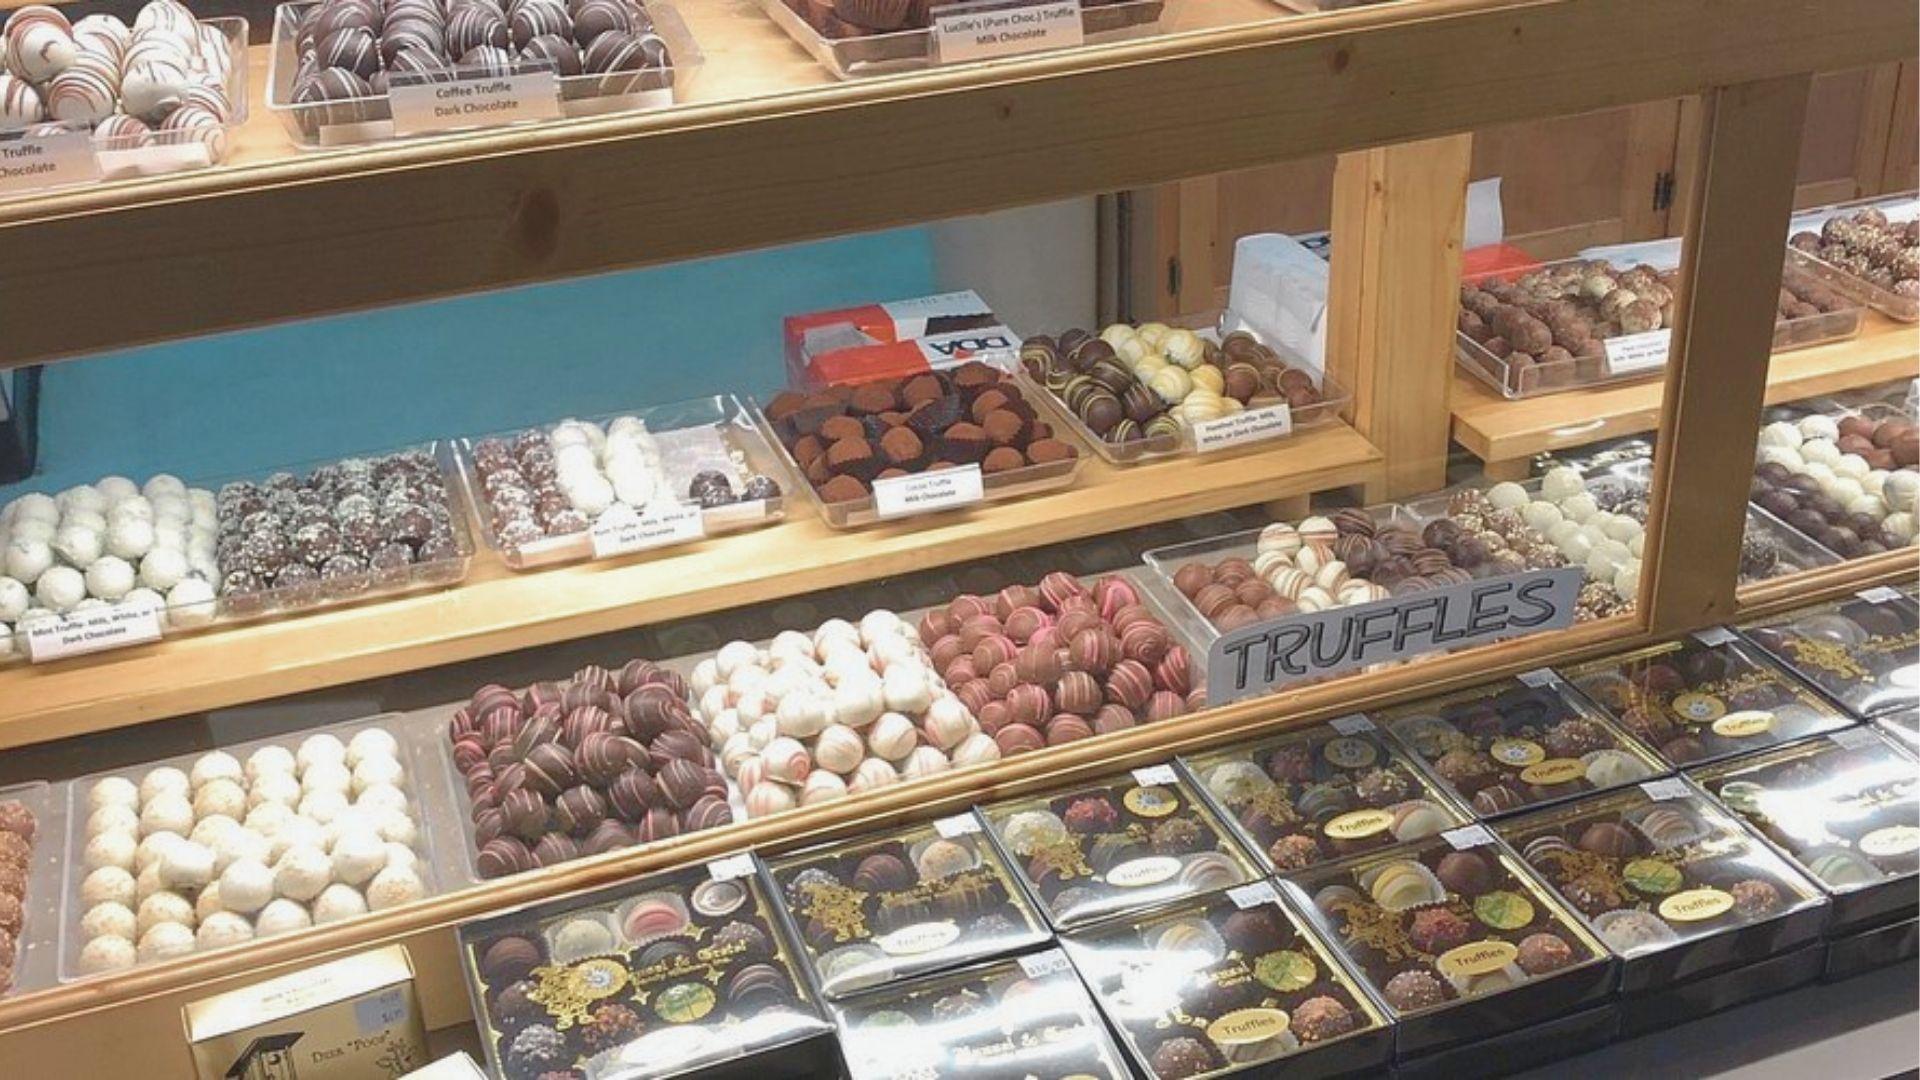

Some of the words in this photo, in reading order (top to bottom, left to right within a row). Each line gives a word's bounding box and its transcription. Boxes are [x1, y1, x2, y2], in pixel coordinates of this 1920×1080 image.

[944, 21, 981, 34] Lucille's
[983, 17, 1009, 31] (Pure
[1011, 11, 1041, 25] Choc.)
[1043, 7, 1074, 19] Truffle
[976, 34, 997, 45] Milk
[1000, 28, 1046, 43] Chocolate
[436, 86, 472, 99] Coffee
[475, 81, 511, 95] Truffle
[434, 106, 461, 117] Dark
[464, 100, 518, 113] Chocolate
[3, 144, 43, 158] Truffle
[62, 634, 82, 645] Dark
[84, 626, 126, 640] Chocolate
[1223, 577, 1556, 690] TRUFFLES
[1338, 815, 1383, 832] Truffles
[1673, 896, 1721, 914] Truffles
[1455, 948, 1506, 967] Truffles
[1222, 1015, 1276, 1035] Truffles
